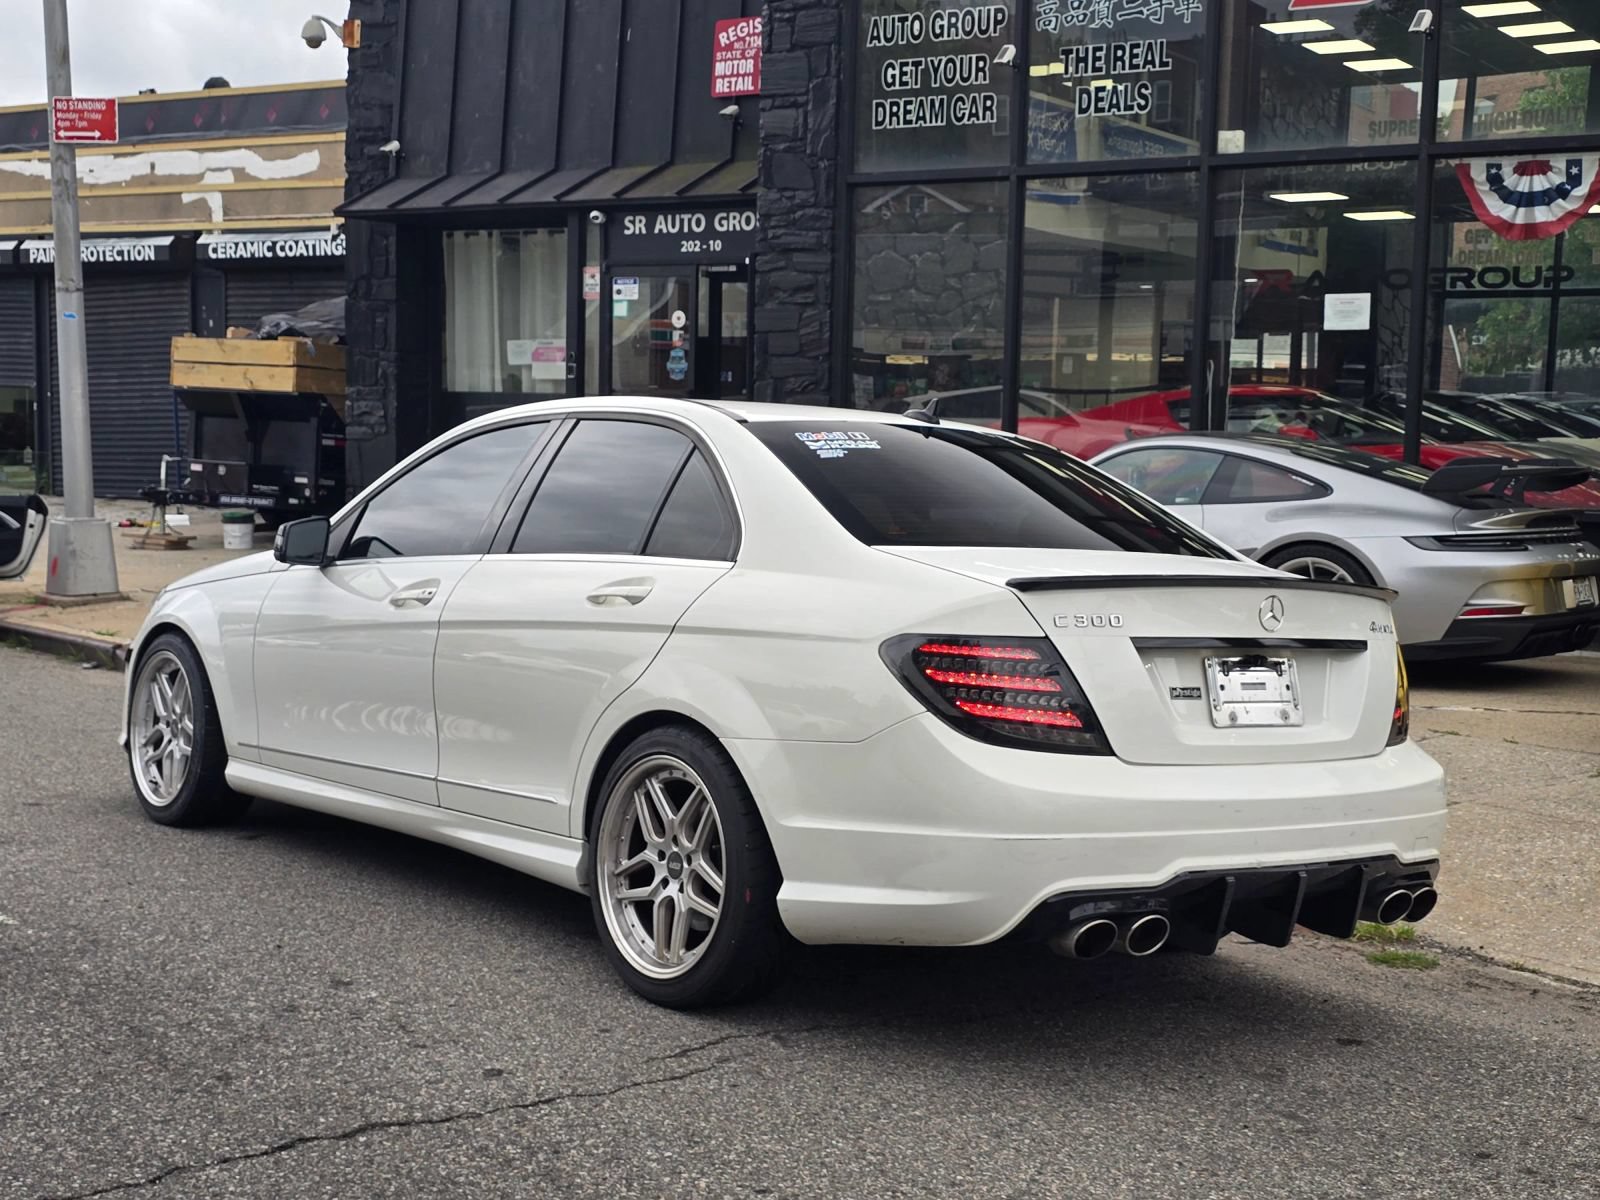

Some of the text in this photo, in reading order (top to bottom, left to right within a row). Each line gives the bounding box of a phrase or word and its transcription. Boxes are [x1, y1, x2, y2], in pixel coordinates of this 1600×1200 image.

[718, 18, 762, 47] REGIS
[866, 6, 1008, 47] AUTO GROUP
[716, 48, 757, 60] STATE OF
[1059, 39, 1172, 78] THE REAL
[715, 58, 754, 77] MOTOR
[882, 54, 989, 91] GET YOUR
[715, 76, 754, 93] RETAIL
[56, 100, 106, 110] NO STANDING
[1075, 81, 1152, 118] DEALS
[56, 111, 79, 120] Monday
[84, 111, 102, 120] Friday
[872, 96, 946, 129] DREAM
[951, 93, 997, 125] CAR
[57, 119, 70, 128] 4pm
[623, 211, 756, 235] SR AUTO GRO
[29, 245, 155, 263] PAIN ROTECTION
[208, 241, 272, 259] CERAMIC
[1053, 613, 1124, 628] C 300
